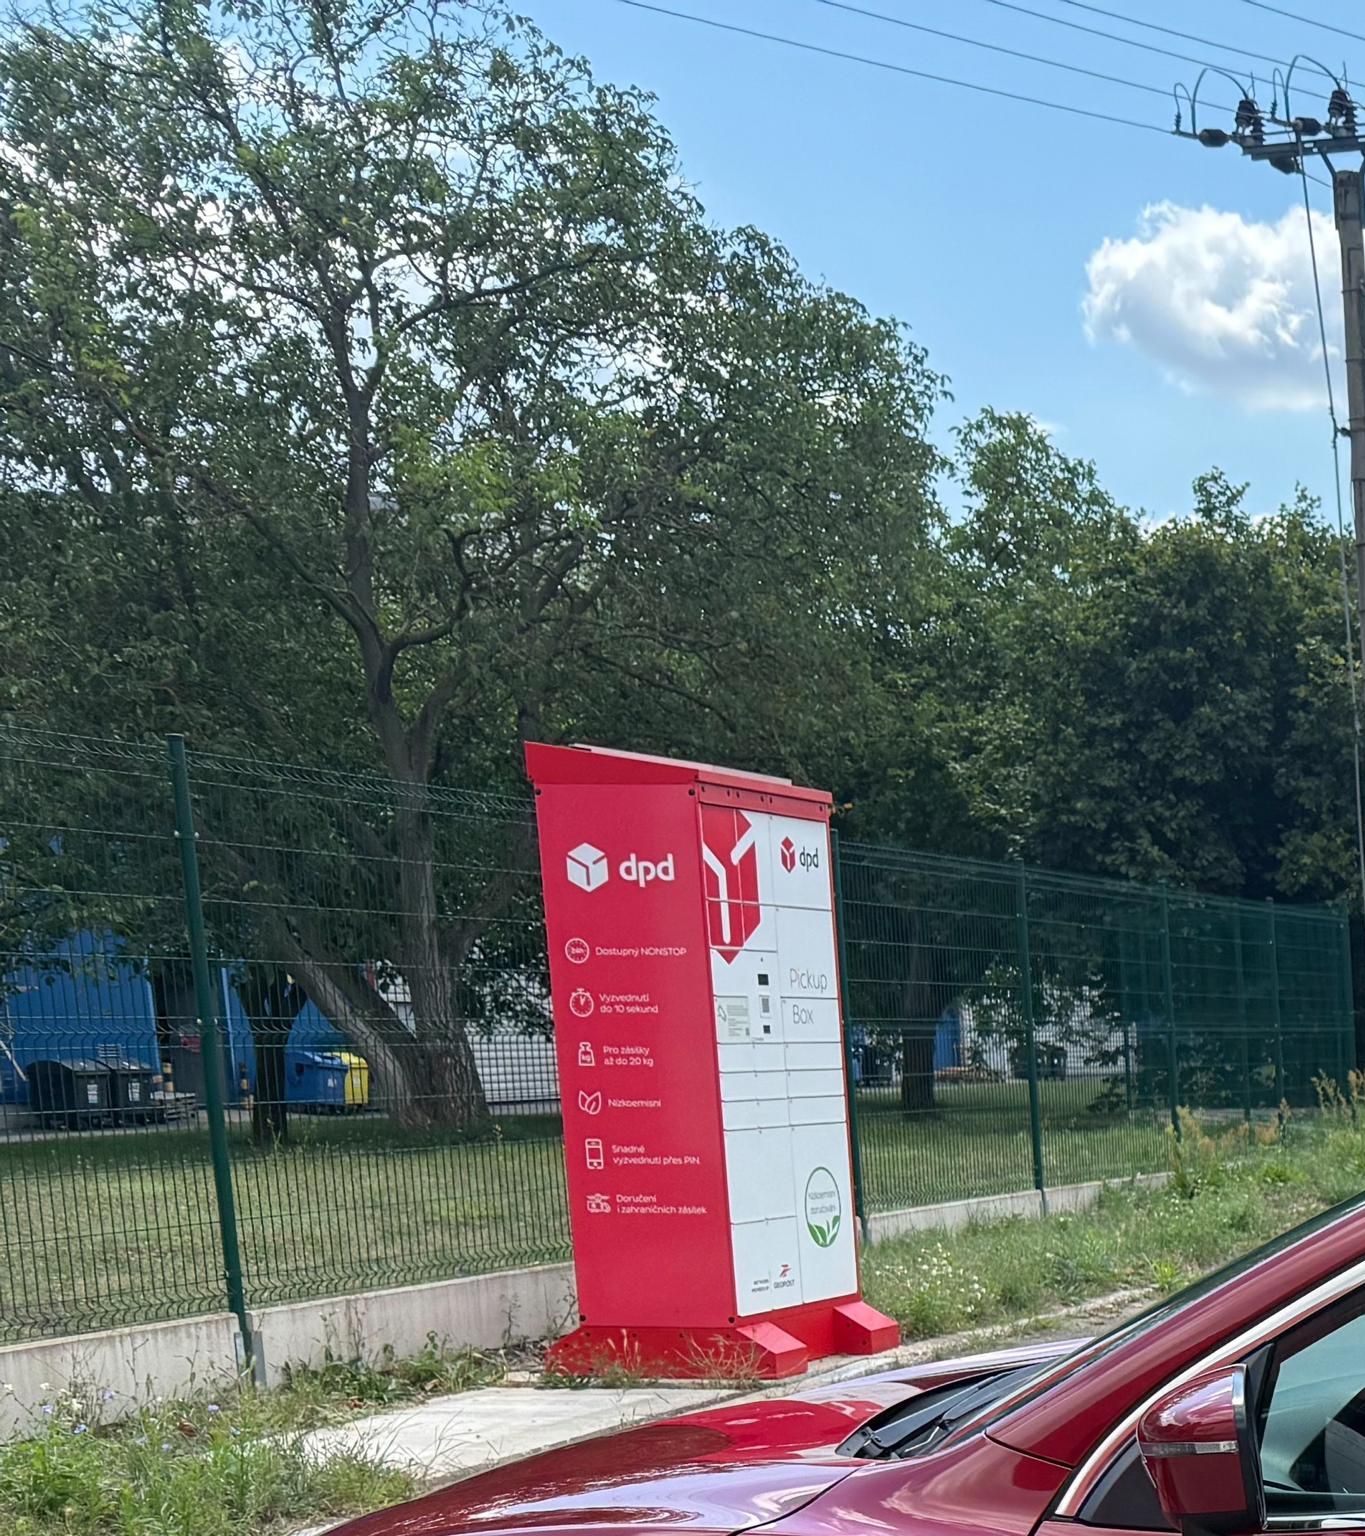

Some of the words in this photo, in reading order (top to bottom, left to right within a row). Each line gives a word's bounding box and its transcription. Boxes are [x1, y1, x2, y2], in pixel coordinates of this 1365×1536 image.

[799, 846, 819, 872] dpd
[619, 852, 675, 888] dpd
[595, 946, 639, 958] Dostupný
[640, 946, 687, 957] NONSTOP
[789, 967, 828, 994] Pickup
[599, 993, 649, 1003] Vyzvednutí
[600, 1004, 612, 1014] do
[614, 1004, 625, 1014] 10
[626, 1004, 659, 1014] sekund
[792, 1003, 814, 1025] Box
[603, 1045, 620, 1055] Pro
[620, 1045, 650, 1057] zásilky
[604, 1056, 615, 1066] až
[616, 1056, 628, 1066] do
[629, 1056, 642, 1066] 20
[643, 1056, 654, 1068] kg
[611, 1144, 646, 1154] Snadné
[663, 1156, 683, 1166] přes
[684, 1155, 700, 1165] PIN
[615, 1193, 657, 1204] Doručení
[678, 1205, 708, 1215] zásilek
